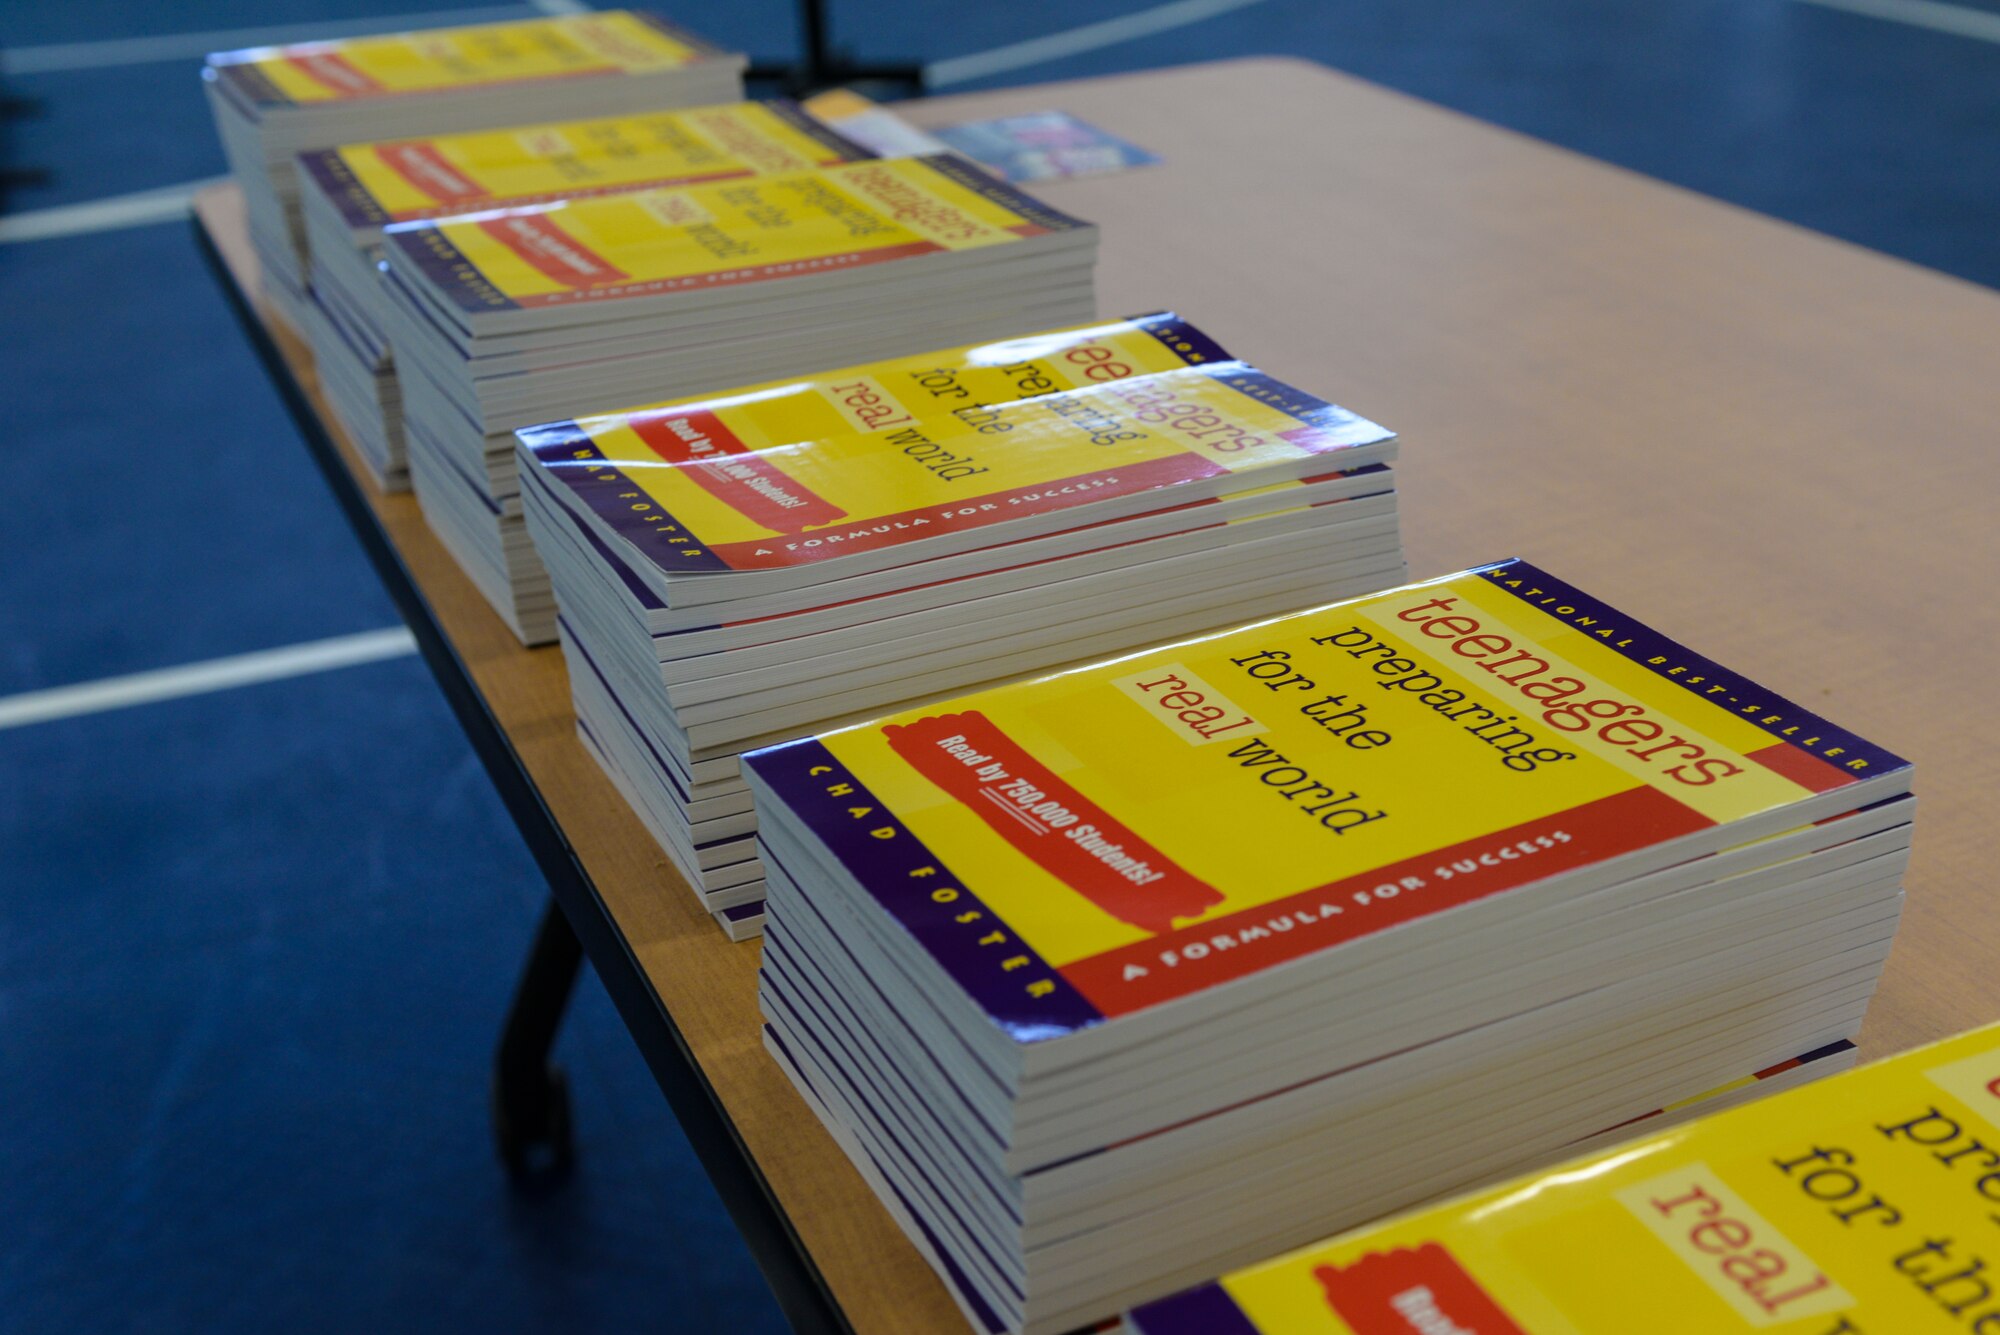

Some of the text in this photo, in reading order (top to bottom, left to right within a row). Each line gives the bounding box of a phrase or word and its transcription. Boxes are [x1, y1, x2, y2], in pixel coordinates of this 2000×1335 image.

[831, 382, 990, 482] real world
[909, 367, 1014, 435] for the
[619, 492, 702, 557] FOSTER
[743, 476, 809, 510] Students!
[754, 476, 1120, 557] A FORMULA FOR SUCCESS
[1229, 650, 1392, 750] for the
[1310, 626, 1577, 773] preparing
[1397, 597, 1745, 787] teenagers
[1487, 568, 1870, 771] NATIONAL BEST-SELLER
[936, 734, 1165, 886] Read by 750,000 Students!
[1136, 674, 1388, 836] real world
[809, 765, 1056, 999] CHAD FOSTER
[1122, 830, 1573, 981] A FORMULA FOR SUCCESS
[1650, 1184, 1832, 1317] real
[1770, 1145, 1903, 1228] for
